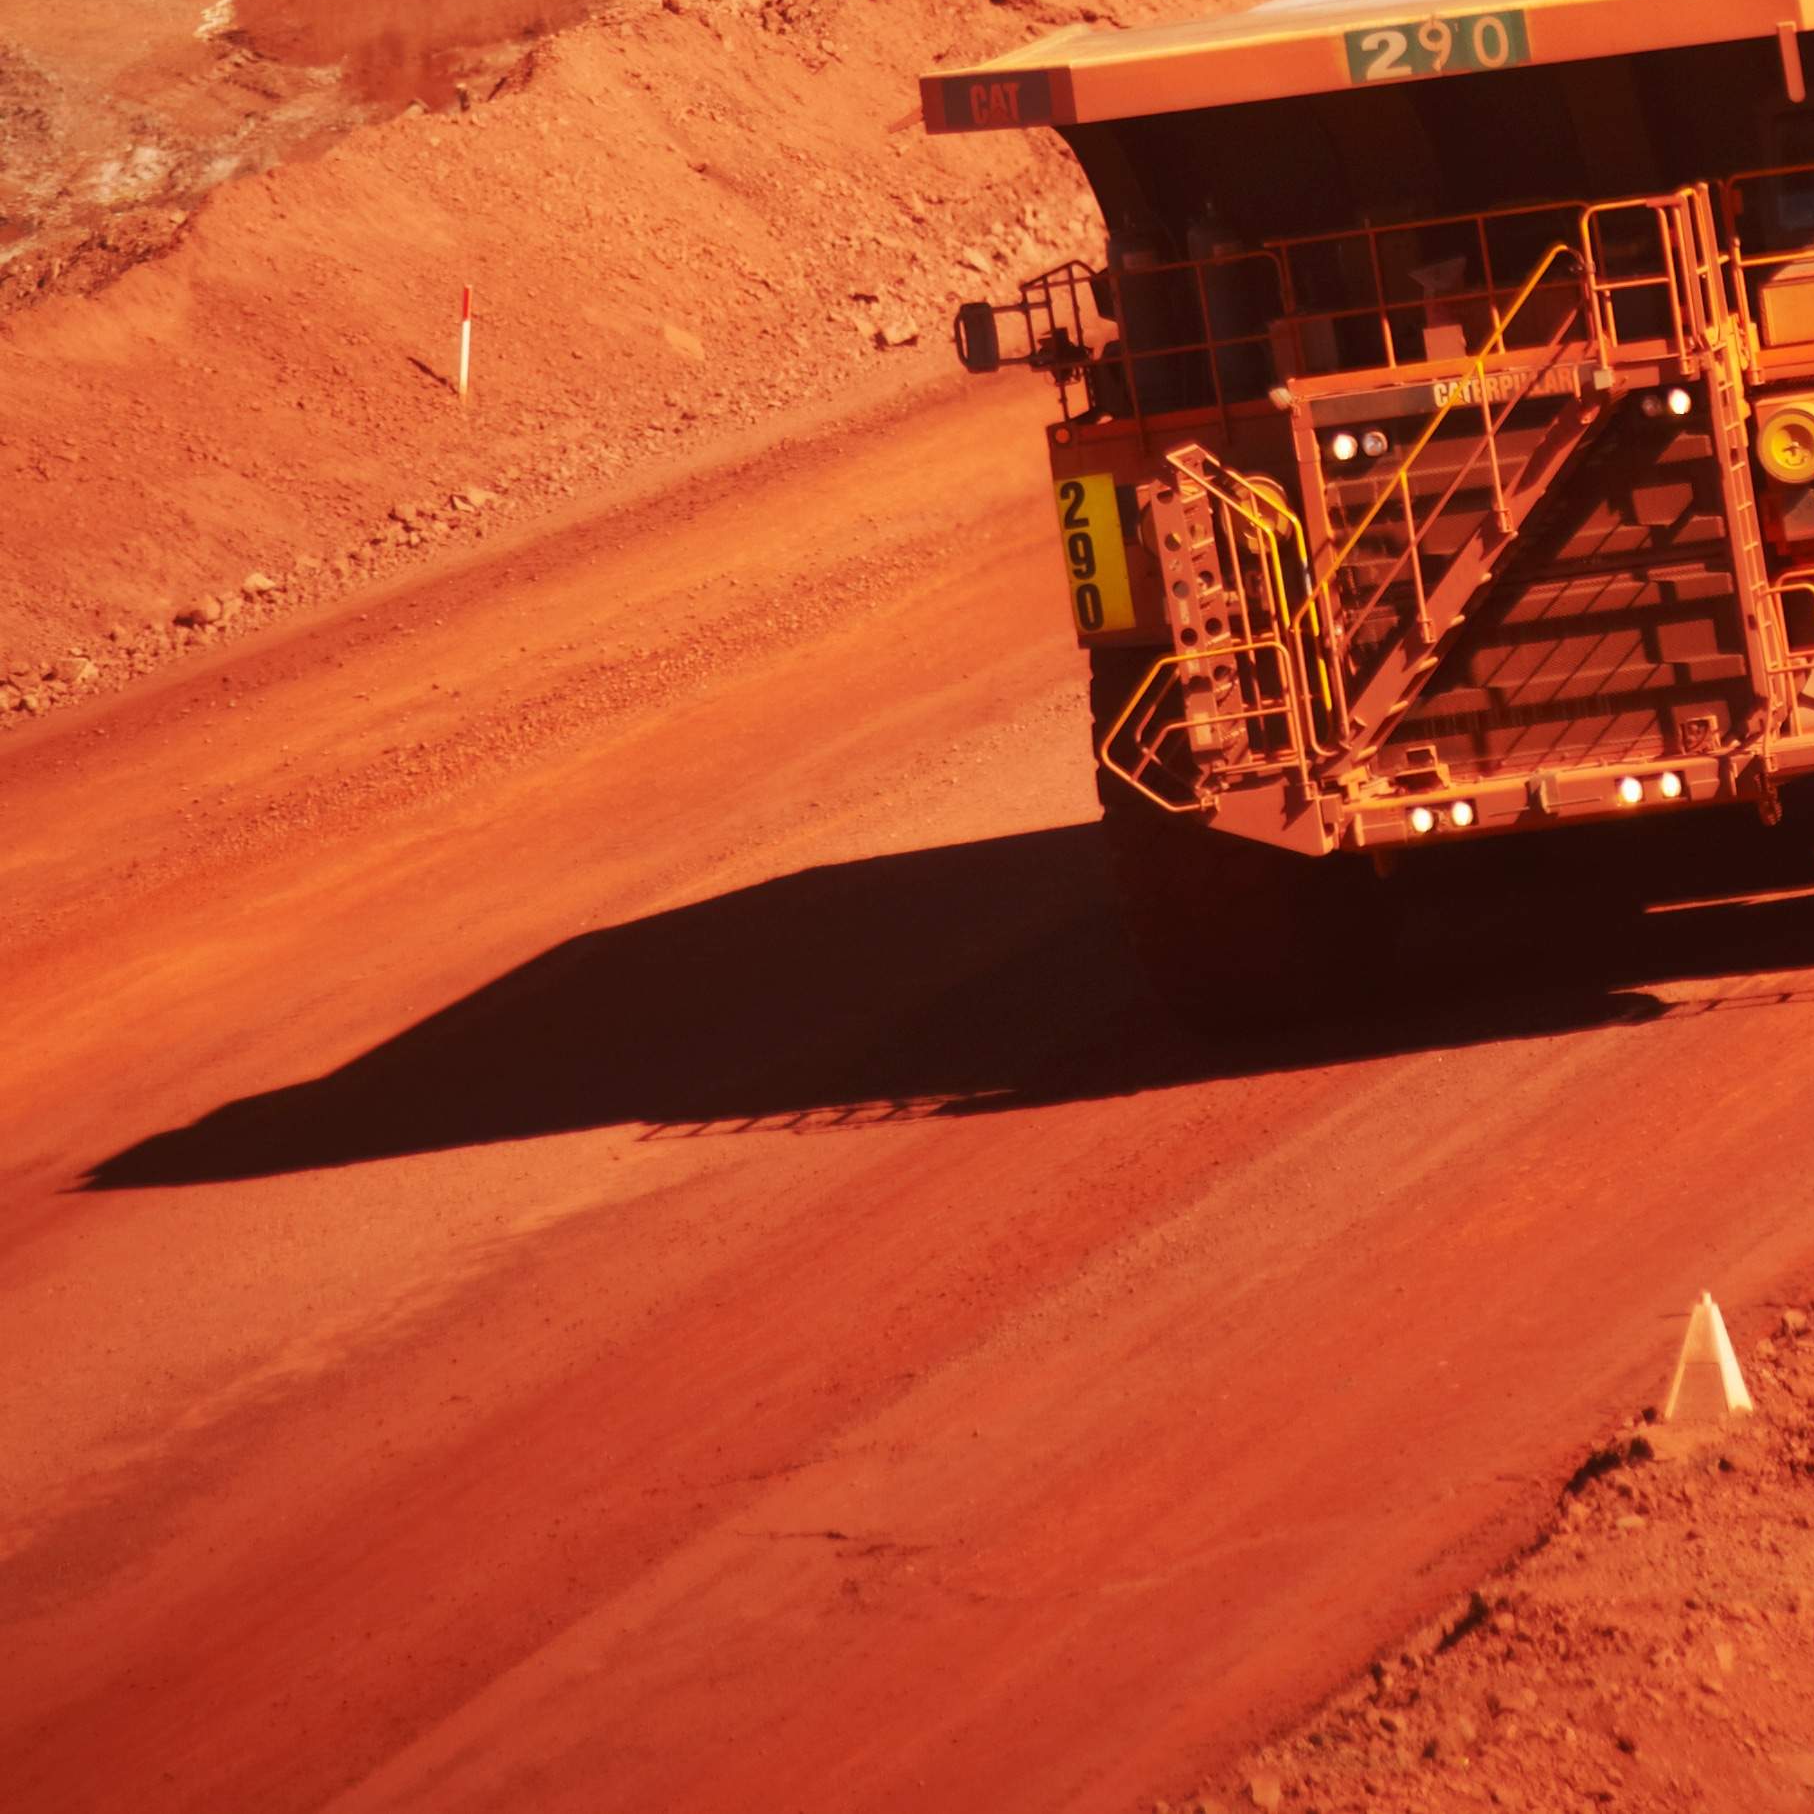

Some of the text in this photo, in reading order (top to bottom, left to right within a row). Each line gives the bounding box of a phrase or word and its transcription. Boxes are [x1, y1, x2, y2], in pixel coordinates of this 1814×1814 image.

[1361, 16, 1509, 81] 290
[969, 81, 1020, 125] CAT
[1059, 481, 1104, 632] 290
